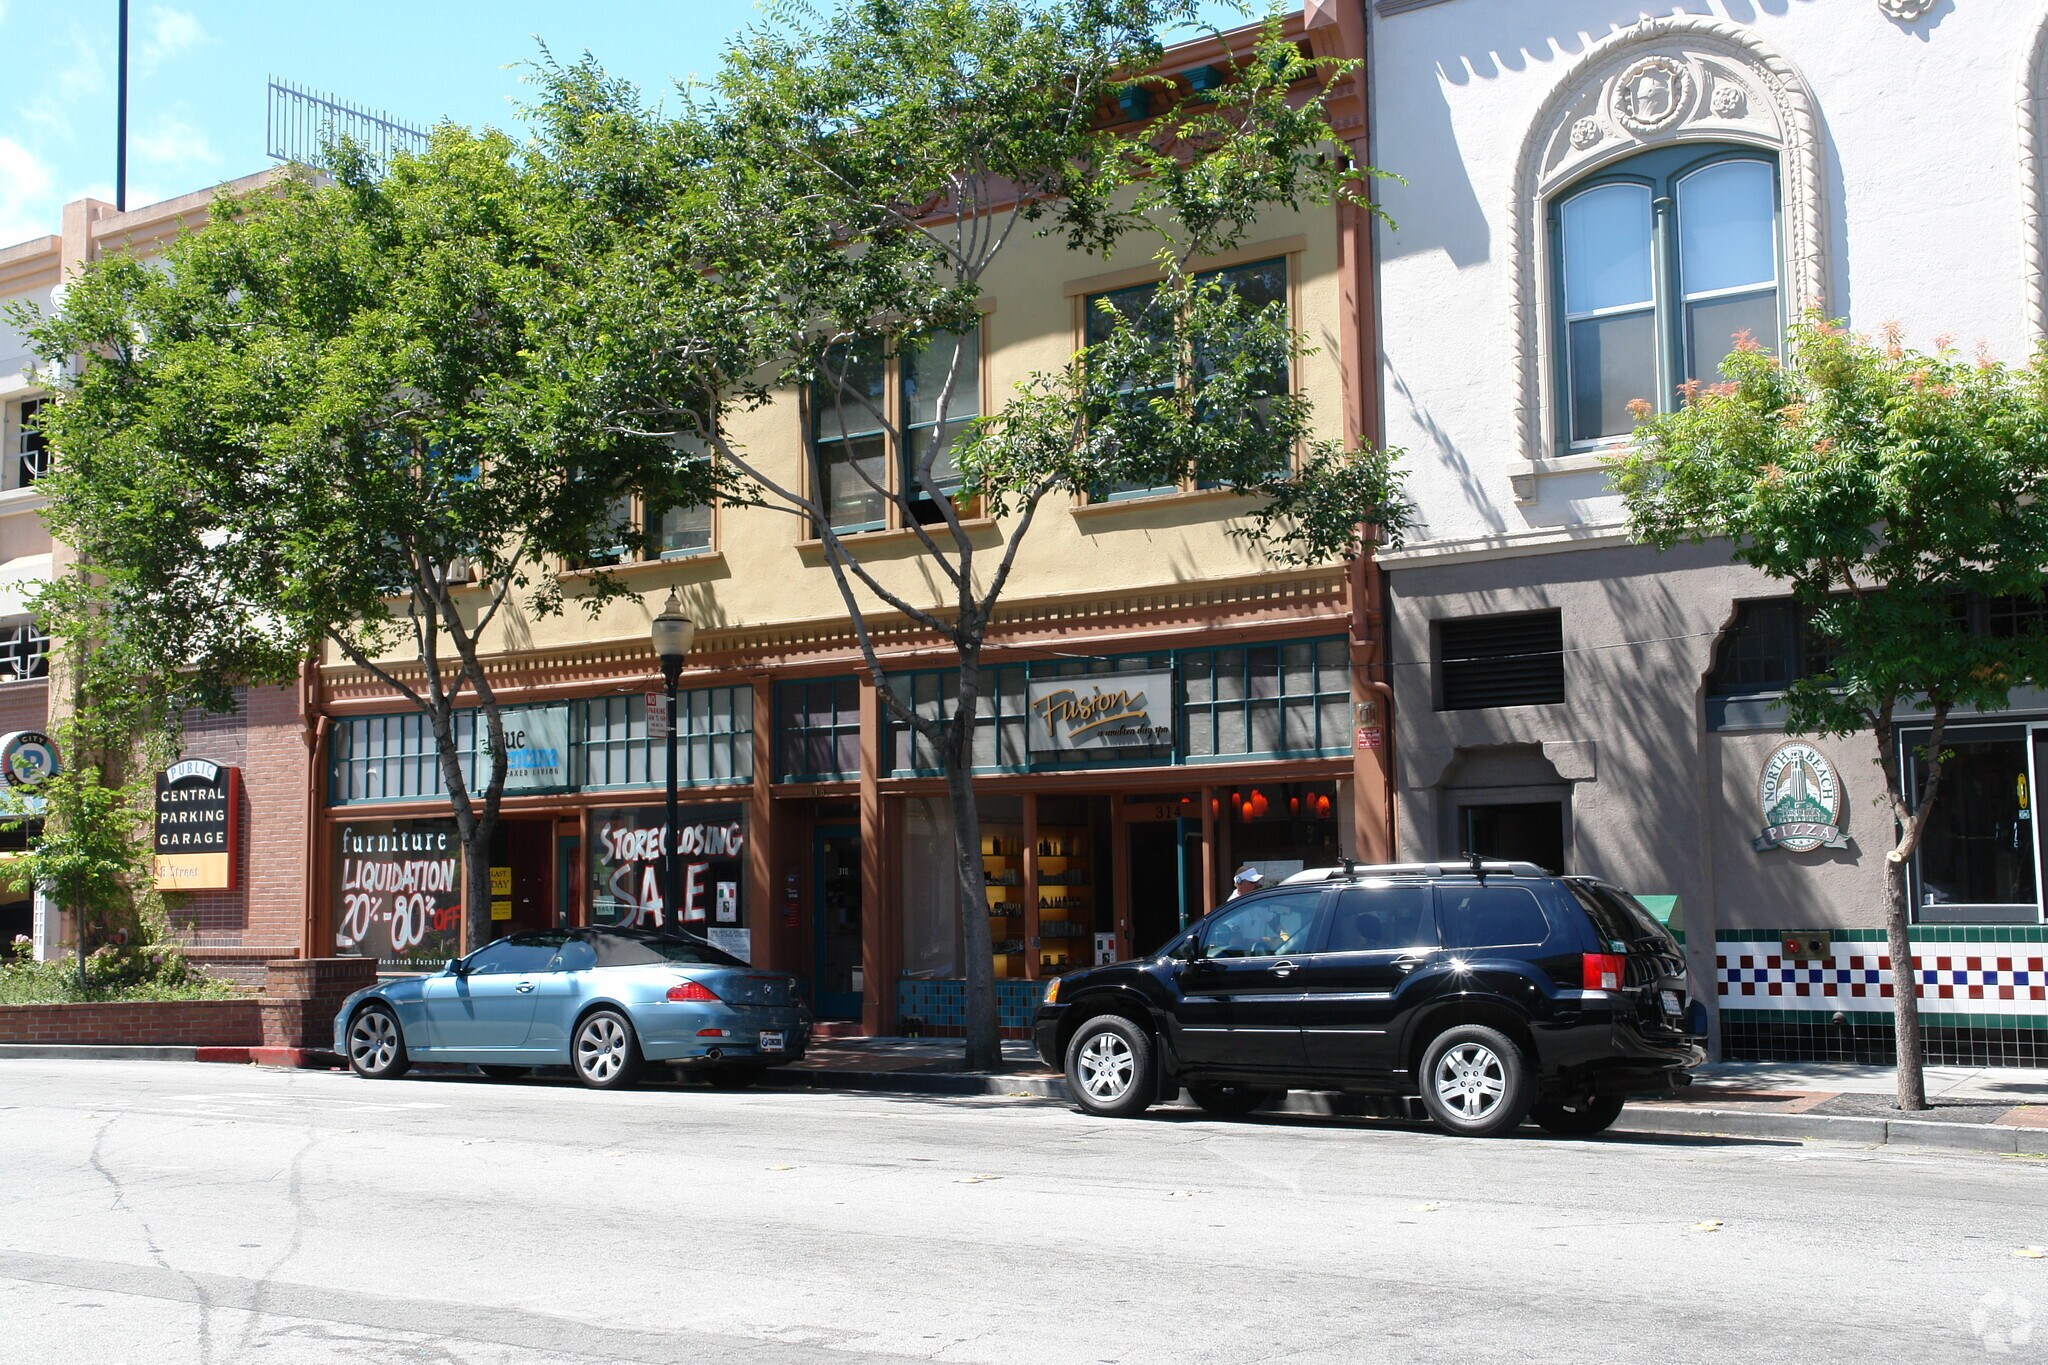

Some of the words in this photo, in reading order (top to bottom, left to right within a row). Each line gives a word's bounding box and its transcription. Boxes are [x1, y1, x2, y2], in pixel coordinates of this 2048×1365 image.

[647, 695, 656, 705] NO
[1032, 685, 1144, 738] Fusion
[1105, 724, 1136, 736] modern
[1137, 722, 1154, 740] day
[1154, 725, 1169, 739] spa
[21, 735, 44, 744] CITY
[23, 749, 44, 779] P
[170, 761, 214, 780] PUBLIC
[532, 767, 559, 777] LIVING
[1764, 751, 1791, 802] NORTH
[1805, 750, 1834, 799] BEACH
[161, 787, 226, 802] CENTRAL
[160, 809, 225, 824] PARKING
[159, 831, 224, 846] GARAGE
[1769, 824, 1831, 840] PIZZA
[342, 826, 447, 854] furniture
[170, 866, 200, 878] Street
[341, 857, 456, 893] LIQUIDATION
[490, 870, 507, 878] LAST
[490, 880, 510, 889] DAY
[433, 905, 461, 931] OFF
